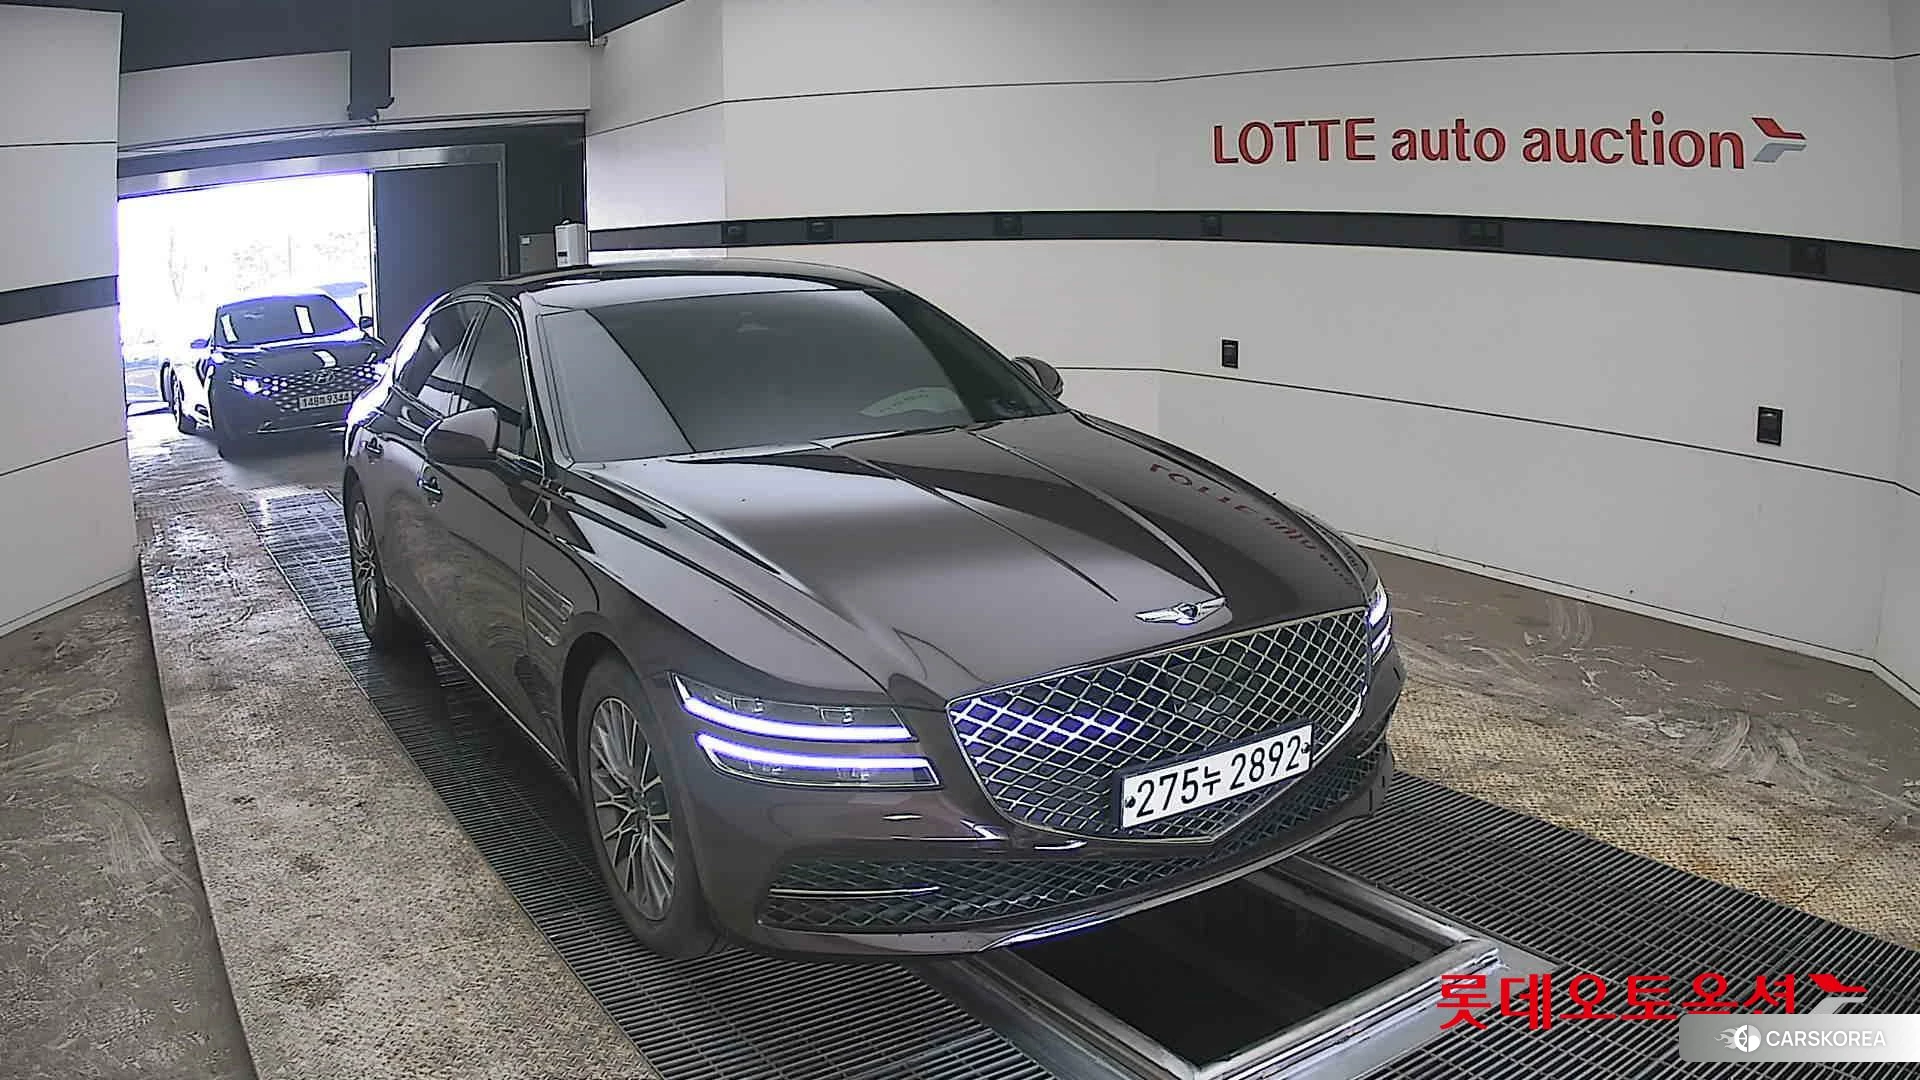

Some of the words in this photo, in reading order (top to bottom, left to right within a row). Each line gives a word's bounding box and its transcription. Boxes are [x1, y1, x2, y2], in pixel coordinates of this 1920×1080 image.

[1213, 118, 1376, 164] LOTTE
[1392, 118, 1506, 162] auto
[1523, 110, 1745, 169] auction
[1136, 766, 1221, 818] 275누
[1229, 735, 1301, 791] 2892
